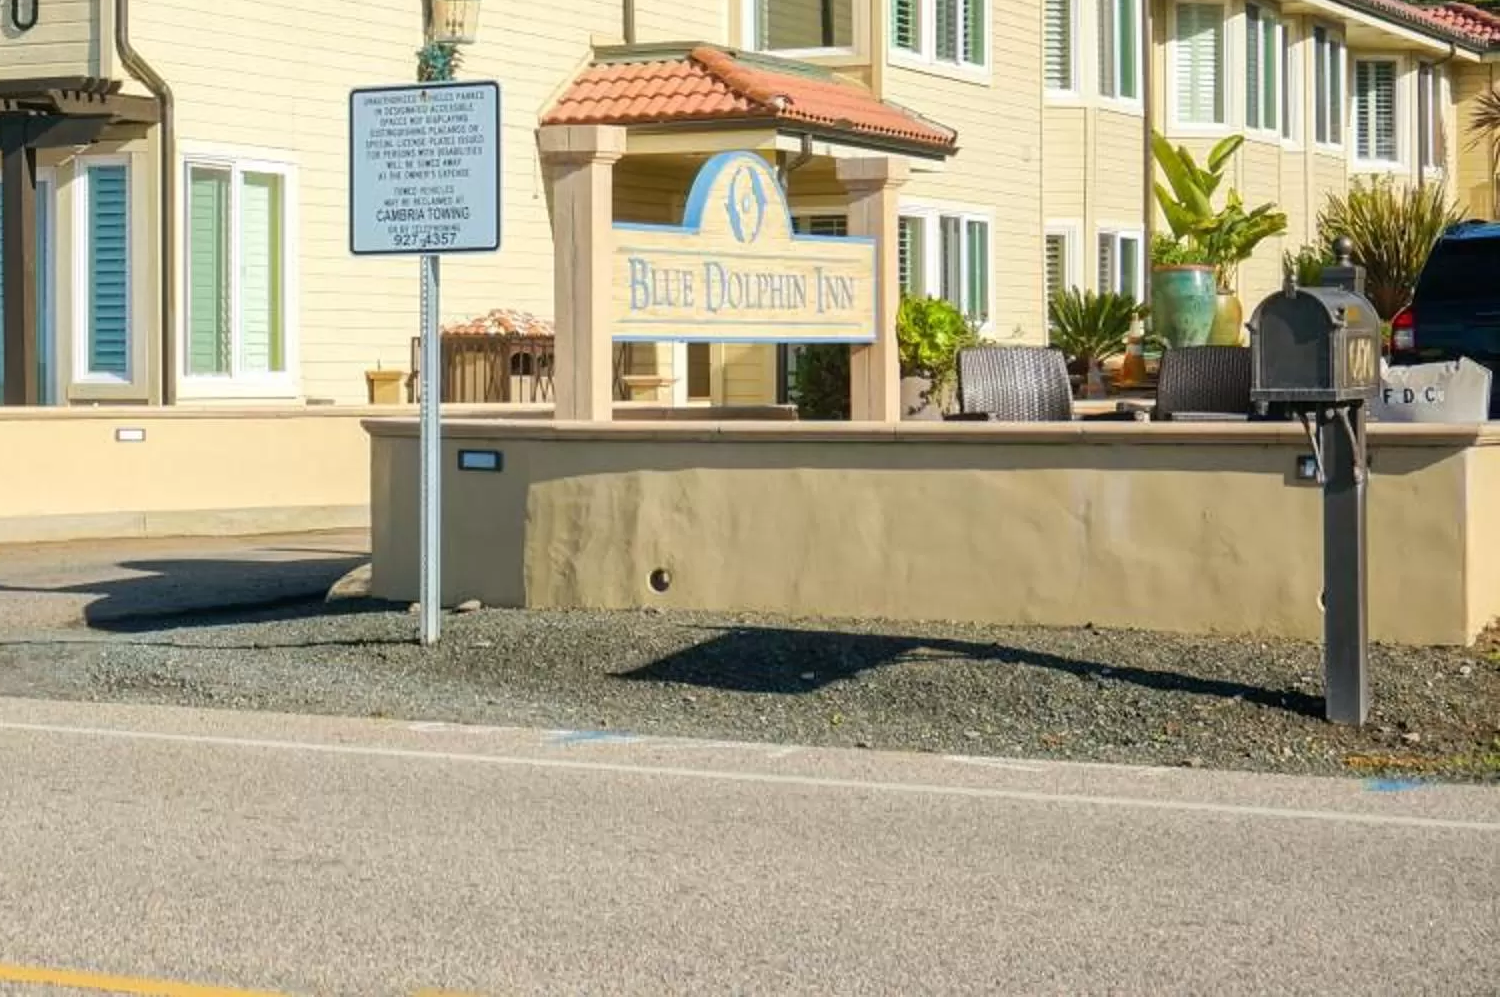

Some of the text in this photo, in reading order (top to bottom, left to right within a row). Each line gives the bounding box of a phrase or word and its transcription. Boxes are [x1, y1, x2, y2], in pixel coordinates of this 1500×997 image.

[375, 206, 470, 222] CAMBRIA TOWING
[393, 232, 457, 246] 927-4357
